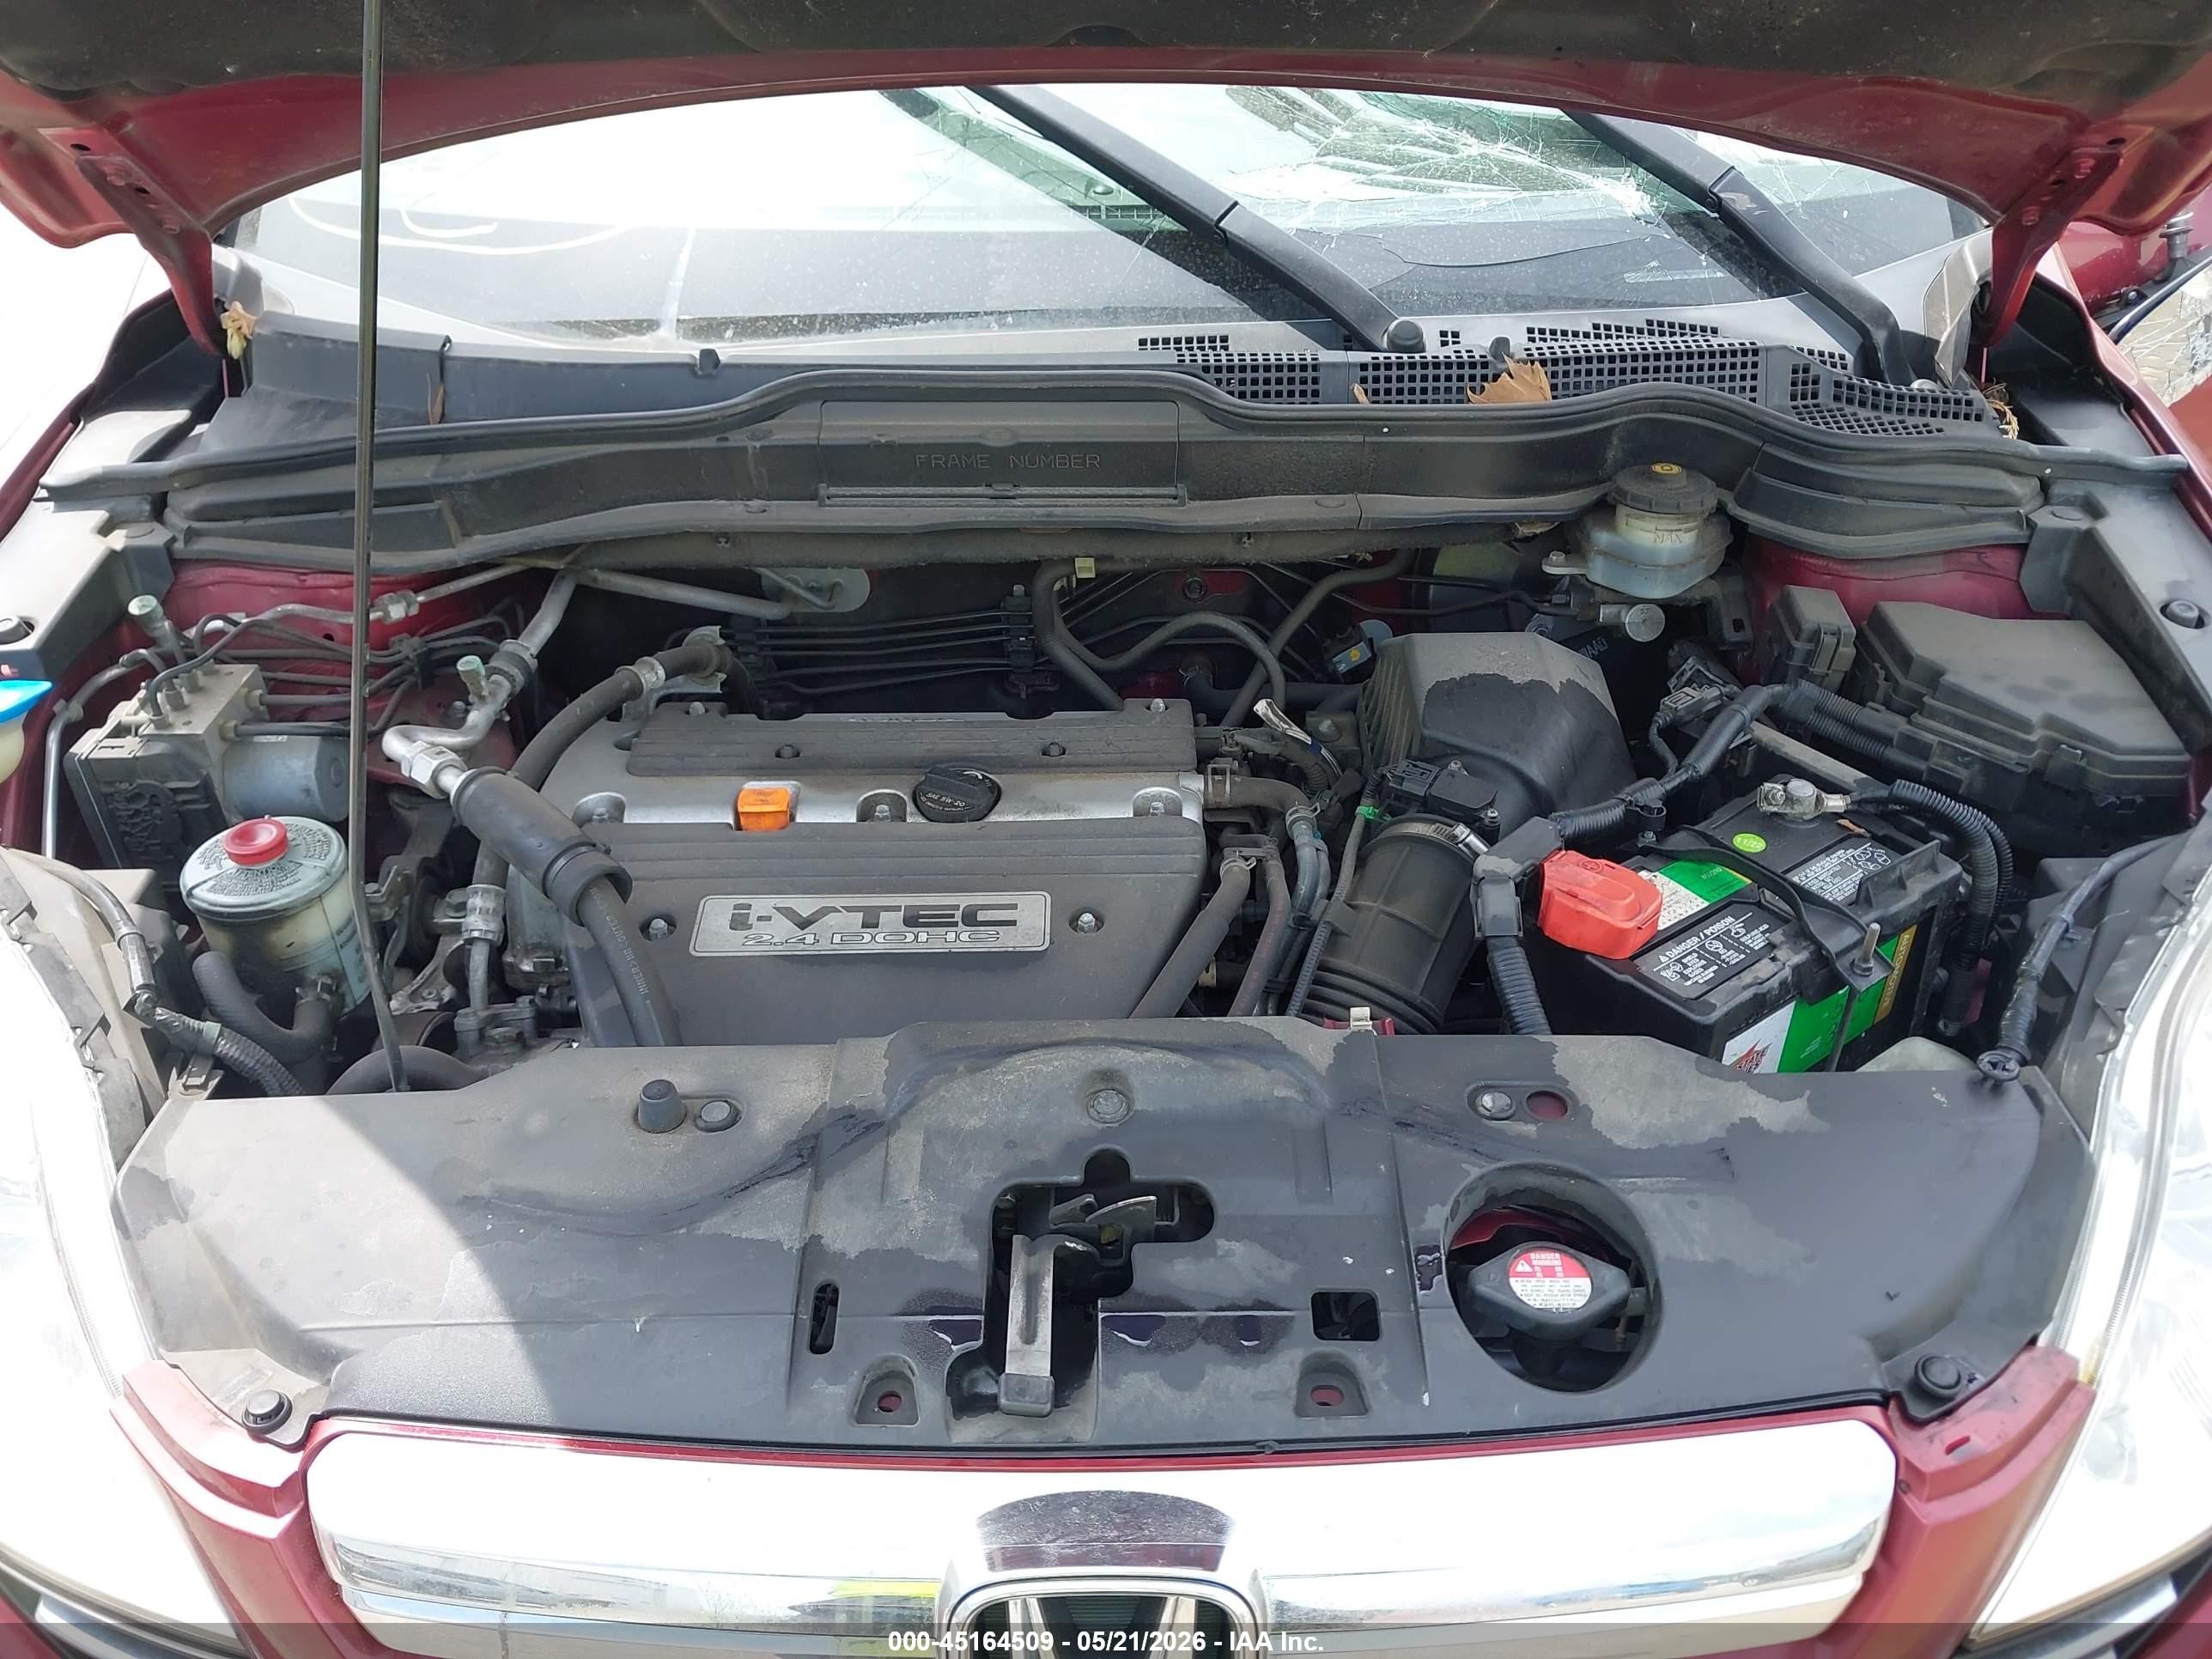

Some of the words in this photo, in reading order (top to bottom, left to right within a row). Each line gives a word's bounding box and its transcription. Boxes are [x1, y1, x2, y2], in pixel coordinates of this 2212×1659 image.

[915, 453, 990, 469] FRAME
[1009, 453, 1101, 469] NUMBER
[1654, 532, 1683, 544] MAX
[926, 792, 940, 800] SAE
[939, 796, 966, 807] 5W-20
[728, 902, 1018, 932] i-VTEC
[741, 932, 820, 946] 2.4
[830, 930, 1000, 945] DOHC
[1665, 935, 1703, 958] DANGER
[1705, 915, 1736, 936] POISON
